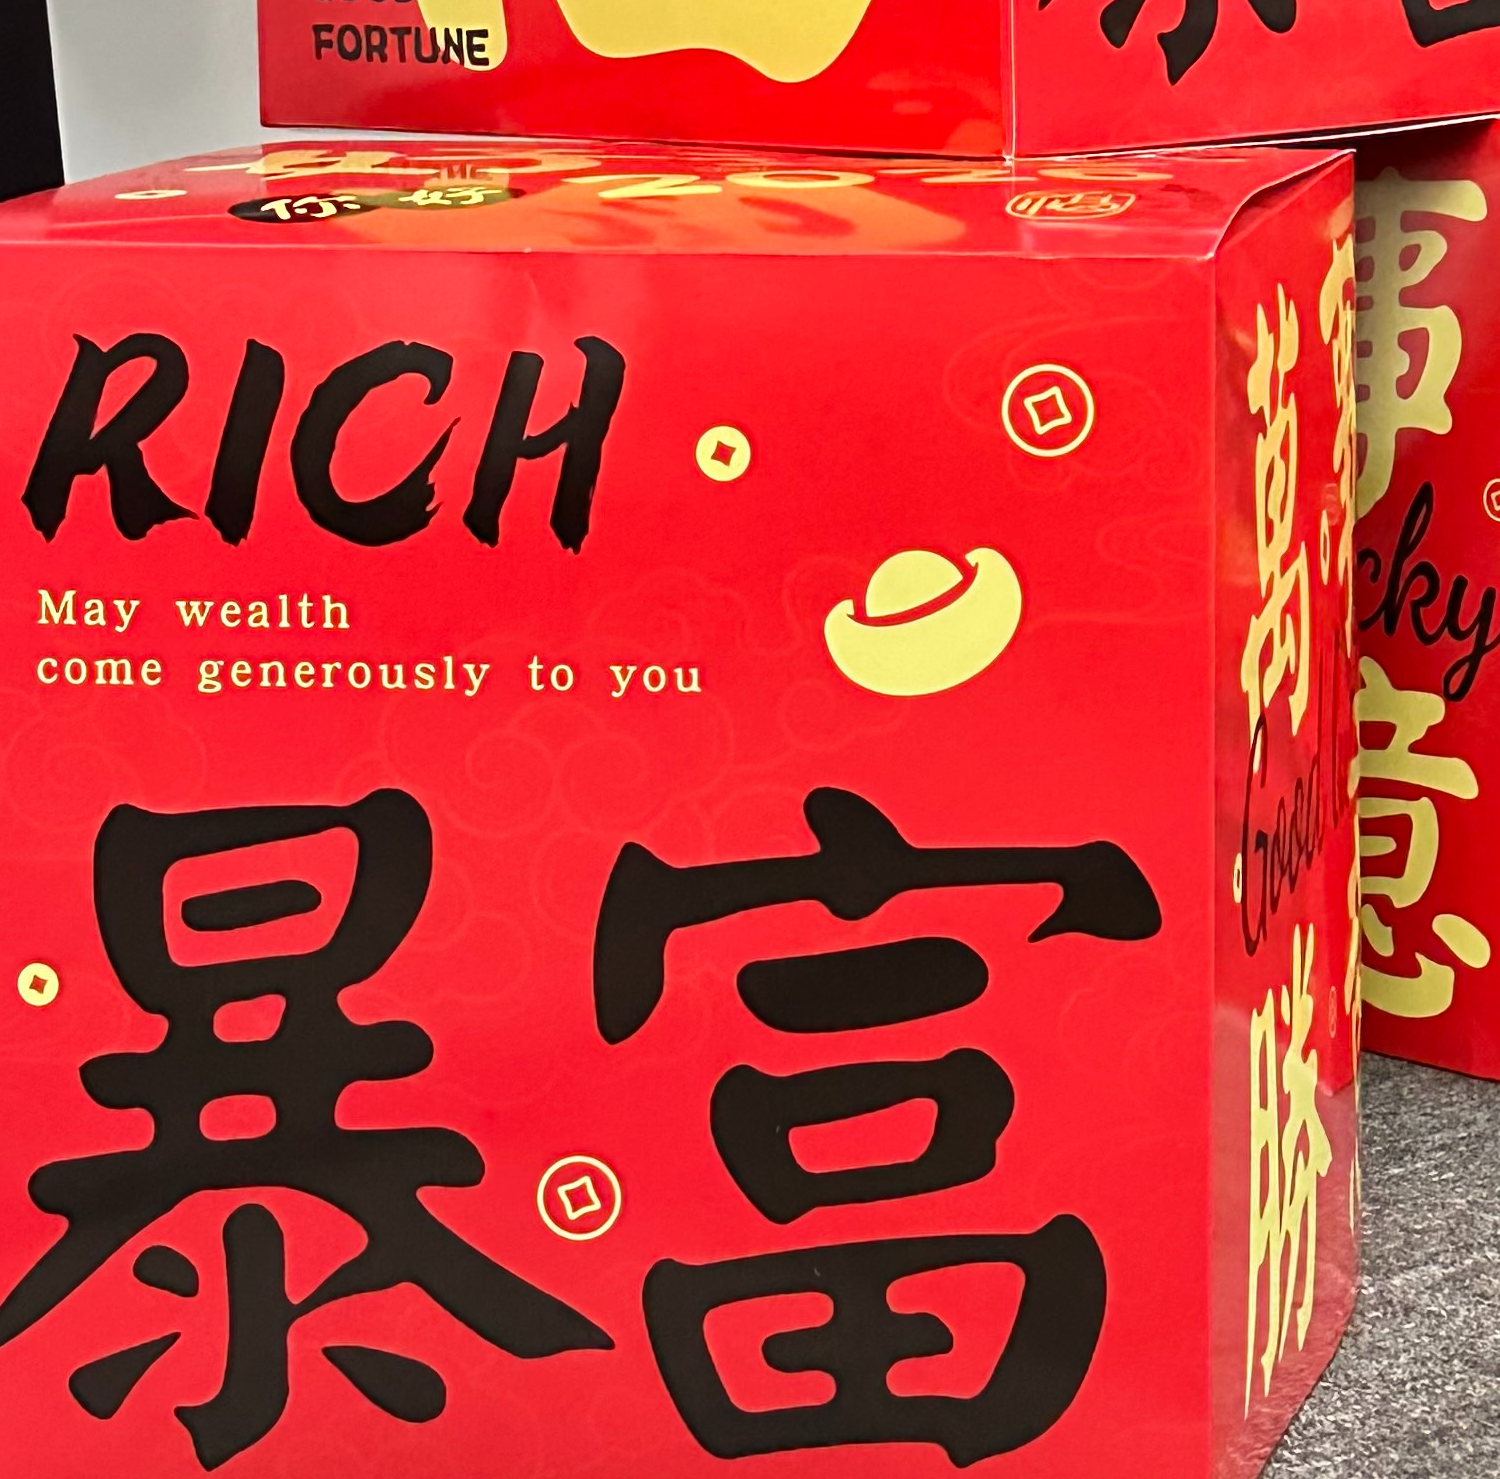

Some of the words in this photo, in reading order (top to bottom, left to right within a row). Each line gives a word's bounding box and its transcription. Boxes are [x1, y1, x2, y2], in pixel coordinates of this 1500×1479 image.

[312, 23, 490, 67] FORTUNE
[21, 331, 626, 554] RICH
[37, 588, 141, 633] May
[175, 593, 350, 629] wealth
[36, 656, 163, 687] come
[197, 656, 491, 697] generously
[527, 655, 575, 691] to
[609, 664, 702, 698] you
[0, 786, 1162, 1471] 暴富
